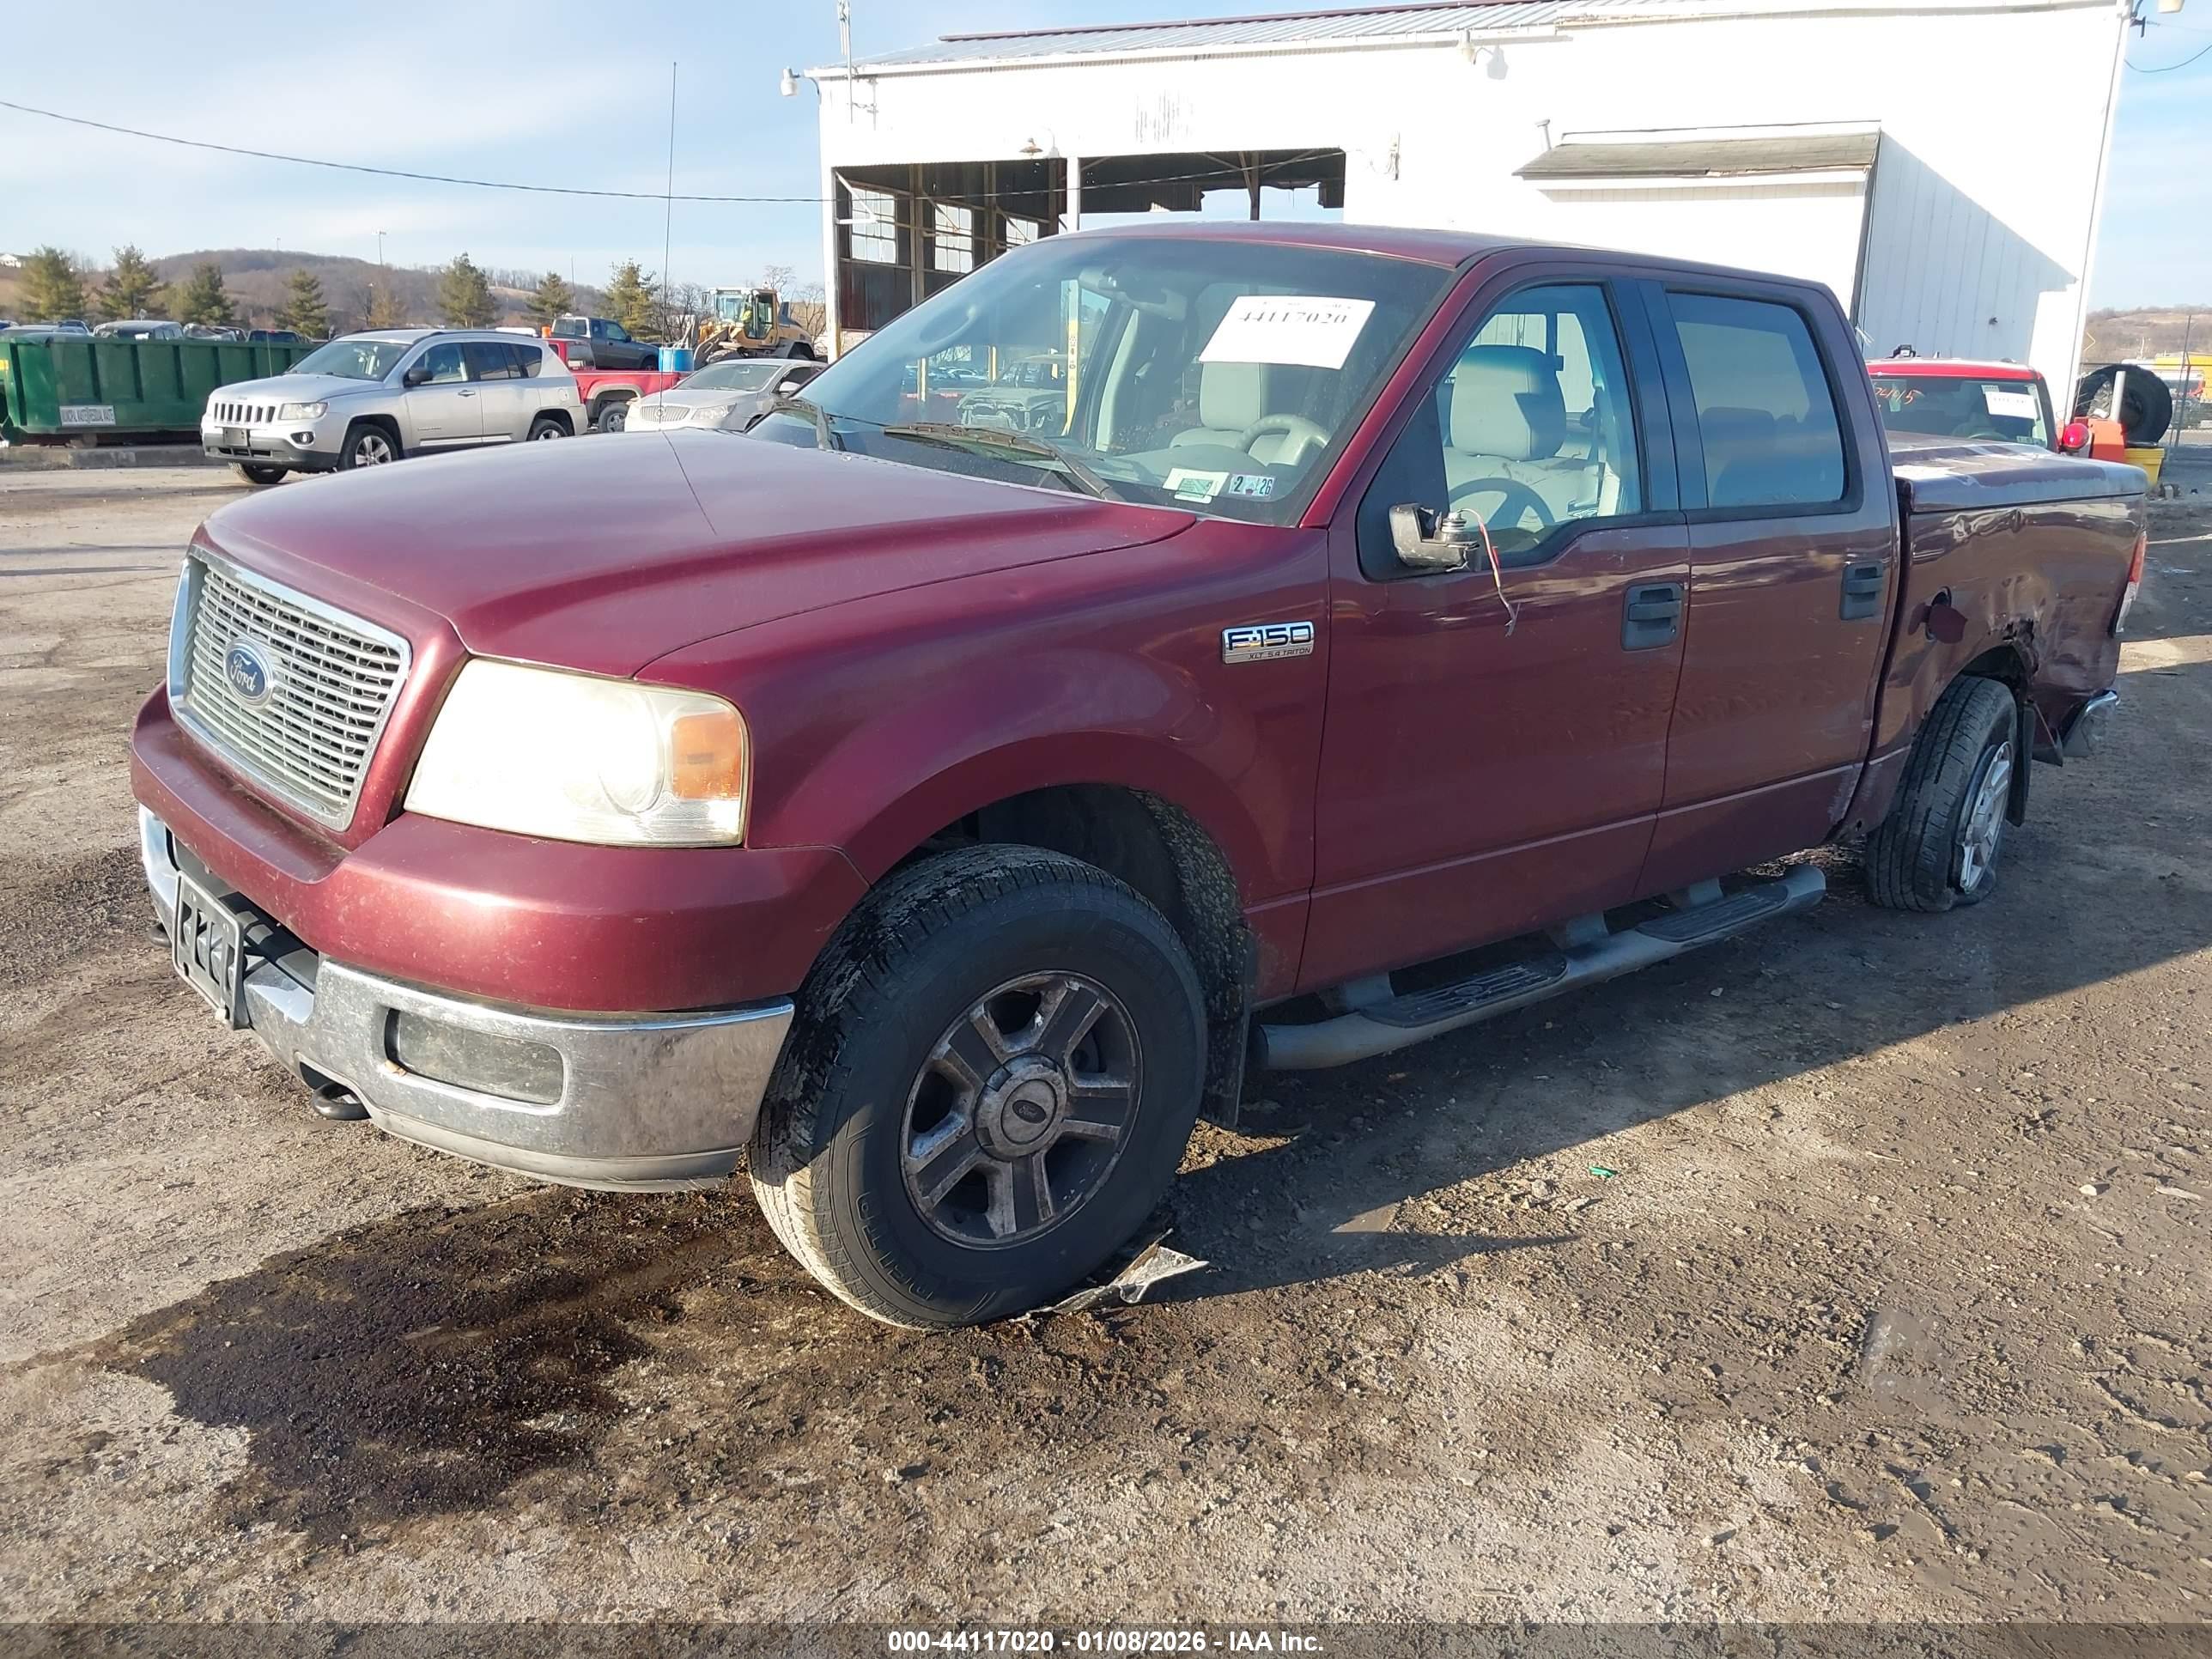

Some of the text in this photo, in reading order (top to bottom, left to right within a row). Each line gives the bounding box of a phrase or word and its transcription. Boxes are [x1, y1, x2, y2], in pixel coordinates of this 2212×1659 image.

[1238, 310, 1348, 325] 44117020
[1232, 475, 1244, 493] 2
[1258, 477, 1273, 495] 26
[1227, 624, 1312, 651] F-150
[1282, 647, 1311, 656] TRITON
[229, 653, 257, 692] Ford
